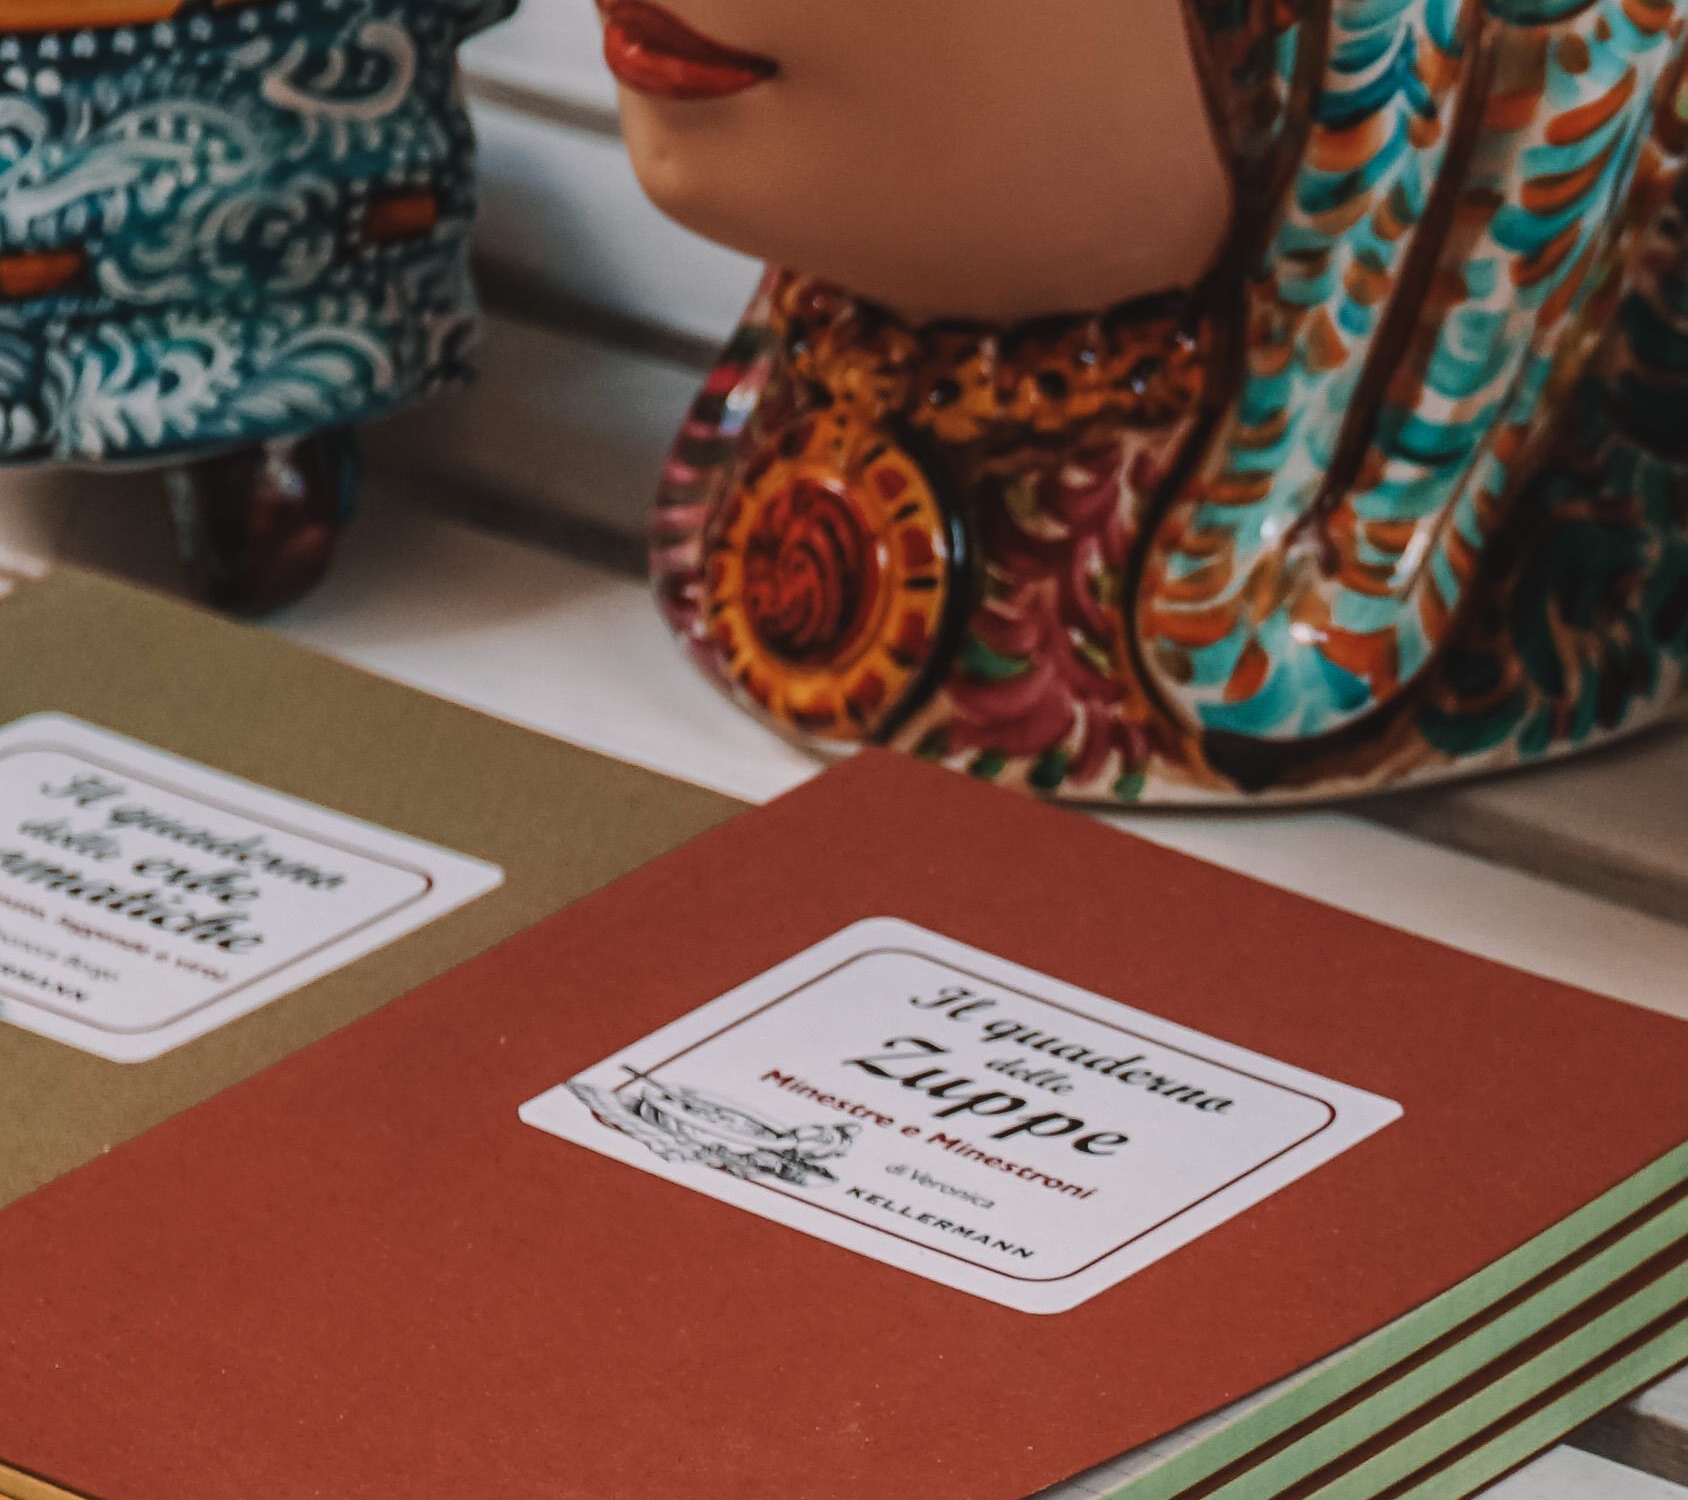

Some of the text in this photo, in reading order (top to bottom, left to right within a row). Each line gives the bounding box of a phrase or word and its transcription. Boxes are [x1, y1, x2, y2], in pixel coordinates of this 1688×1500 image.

[842, 1035, 1130, 1157] Zuppe
[910, 986, 1236, 1116] Il quaderno
[984, 1055, 1076, 1096] delle
[759, 1067, 1099, 1202] Minestre e Minestroni
[845, 1185, 1037, 1261] KELLERMANN
[884, 1161, 997, 1210] di Veronica
